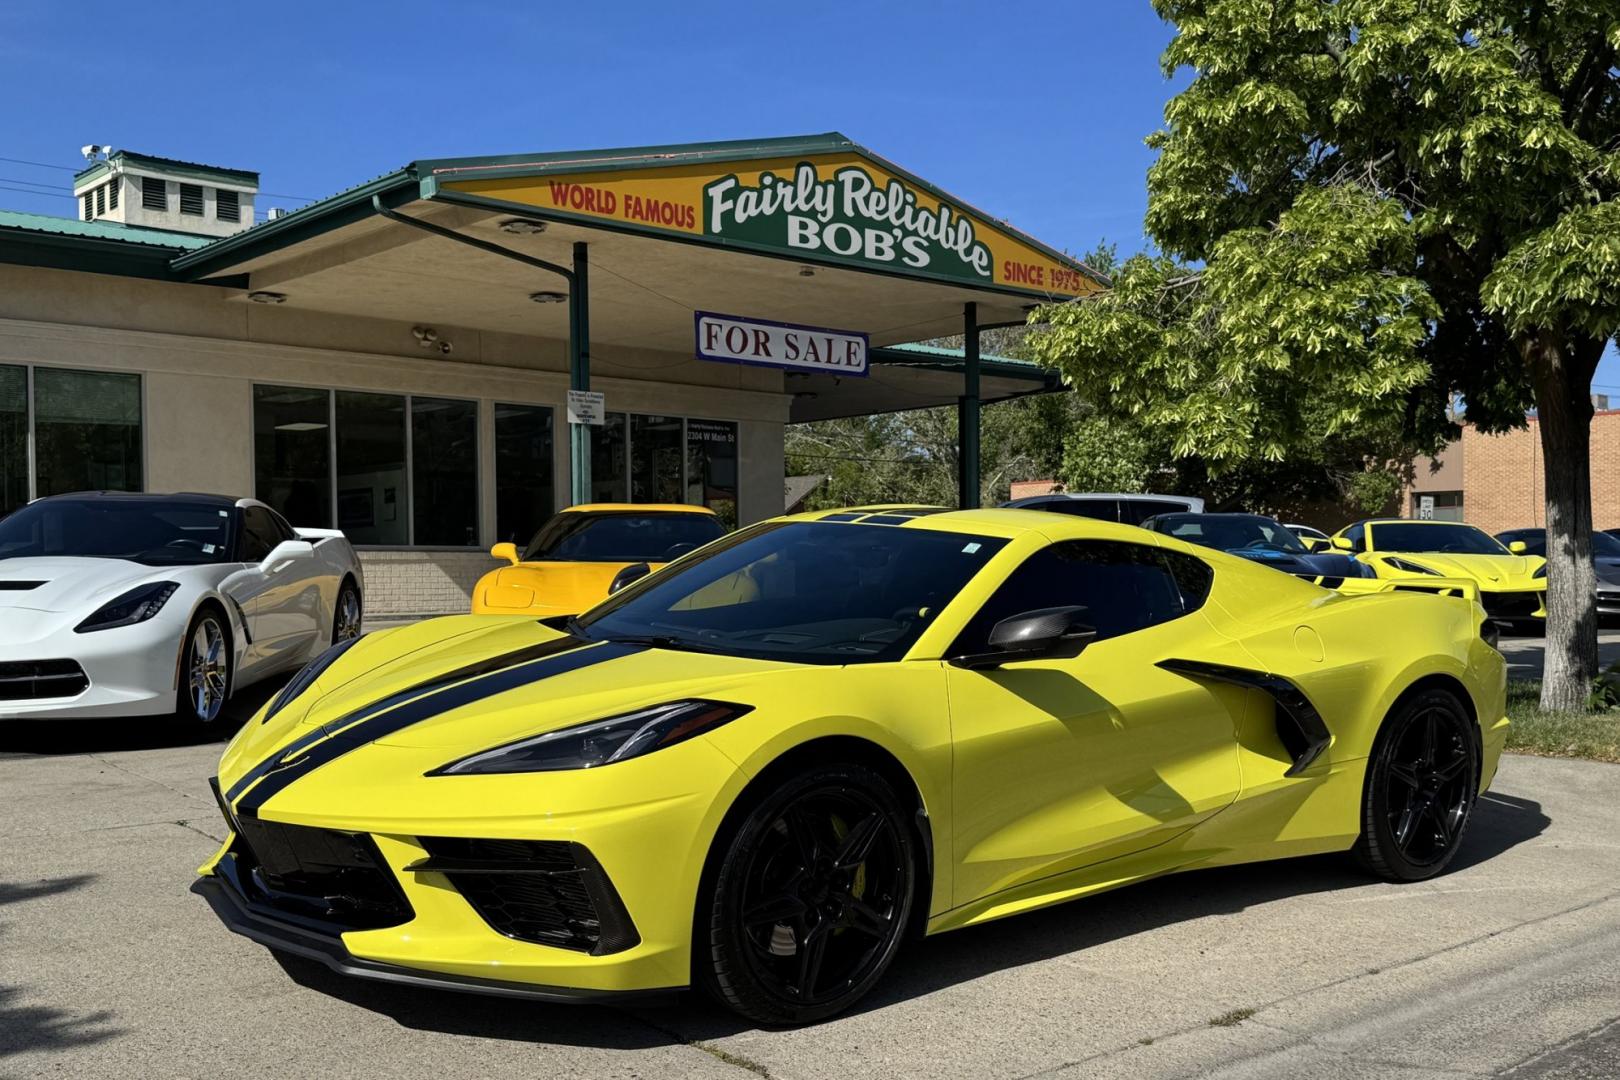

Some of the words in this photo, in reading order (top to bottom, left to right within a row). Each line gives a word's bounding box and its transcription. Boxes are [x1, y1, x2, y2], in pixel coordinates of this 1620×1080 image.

[549, 180, 617, 215] WORLD
[624, 194, 696, 229] FAMOUS
[708, 165, 835, 234] Fairly
[838, 169, 991, 277] Reliable
[787, 214, 931, 268] BOB'S
[1003, 260, 1044, 286] SINCE
[1049, 268, 1080, 292] 1975
[704, 322, 773, 358] FOR
[784, 333, 861, 368] SALE
[687, 431, 703, 441] 2304
[703, 432, 711, 441] W
[711, 432, 726, 442] Main
[728, 433, 735, 443] St
